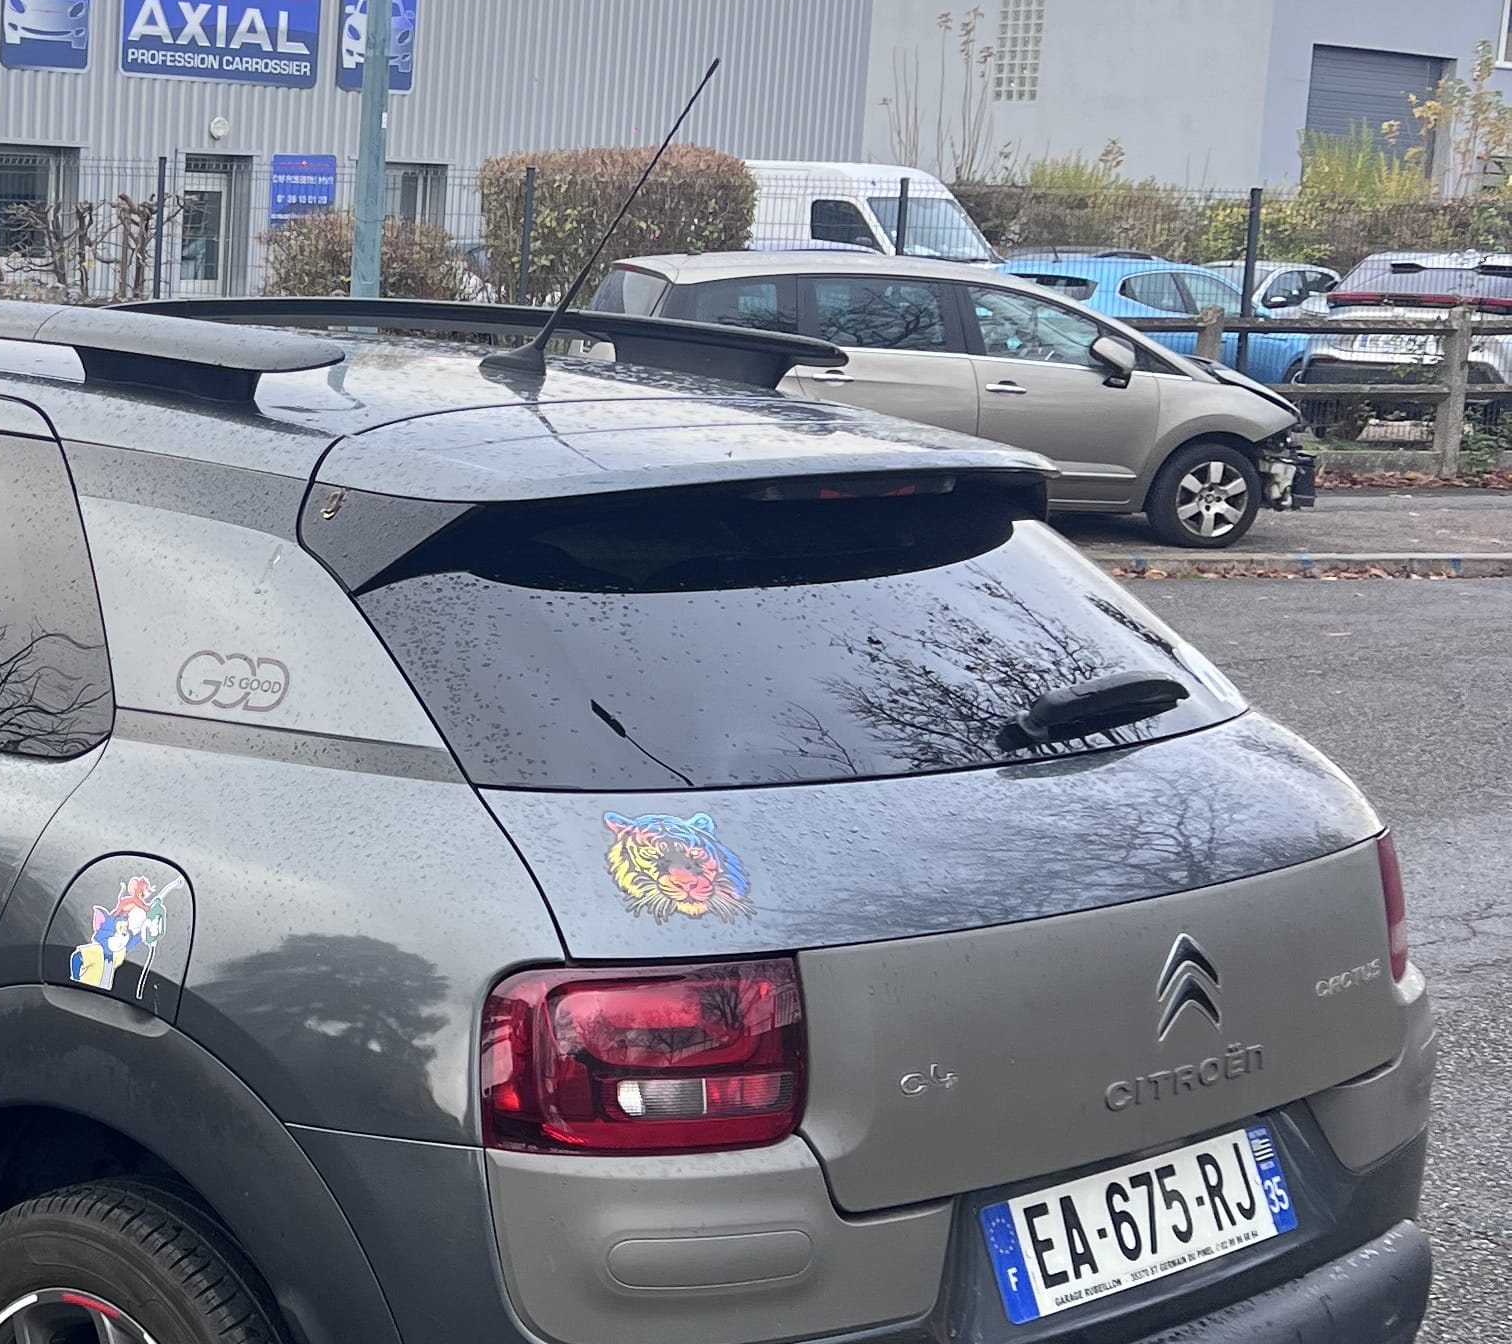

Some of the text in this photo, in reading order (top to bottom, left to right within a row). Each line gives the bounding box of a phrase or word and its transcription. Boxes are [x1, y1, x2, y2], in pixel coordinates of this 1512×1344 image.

[127, 48, 311, 76] PROFESSION CARROSSIER
[176, 649, 290, 712] GOD
[223, 675, 282, 694] IS GOOD
[1315, 958, 1382, 997] CACTUS
[1006, 1142, 1290, 1292] F EA-675-RJ 35
[1055, 1289, 1085, 1307] GARAGE
[1159, 1255, 1187, 1272] GERMAIN
